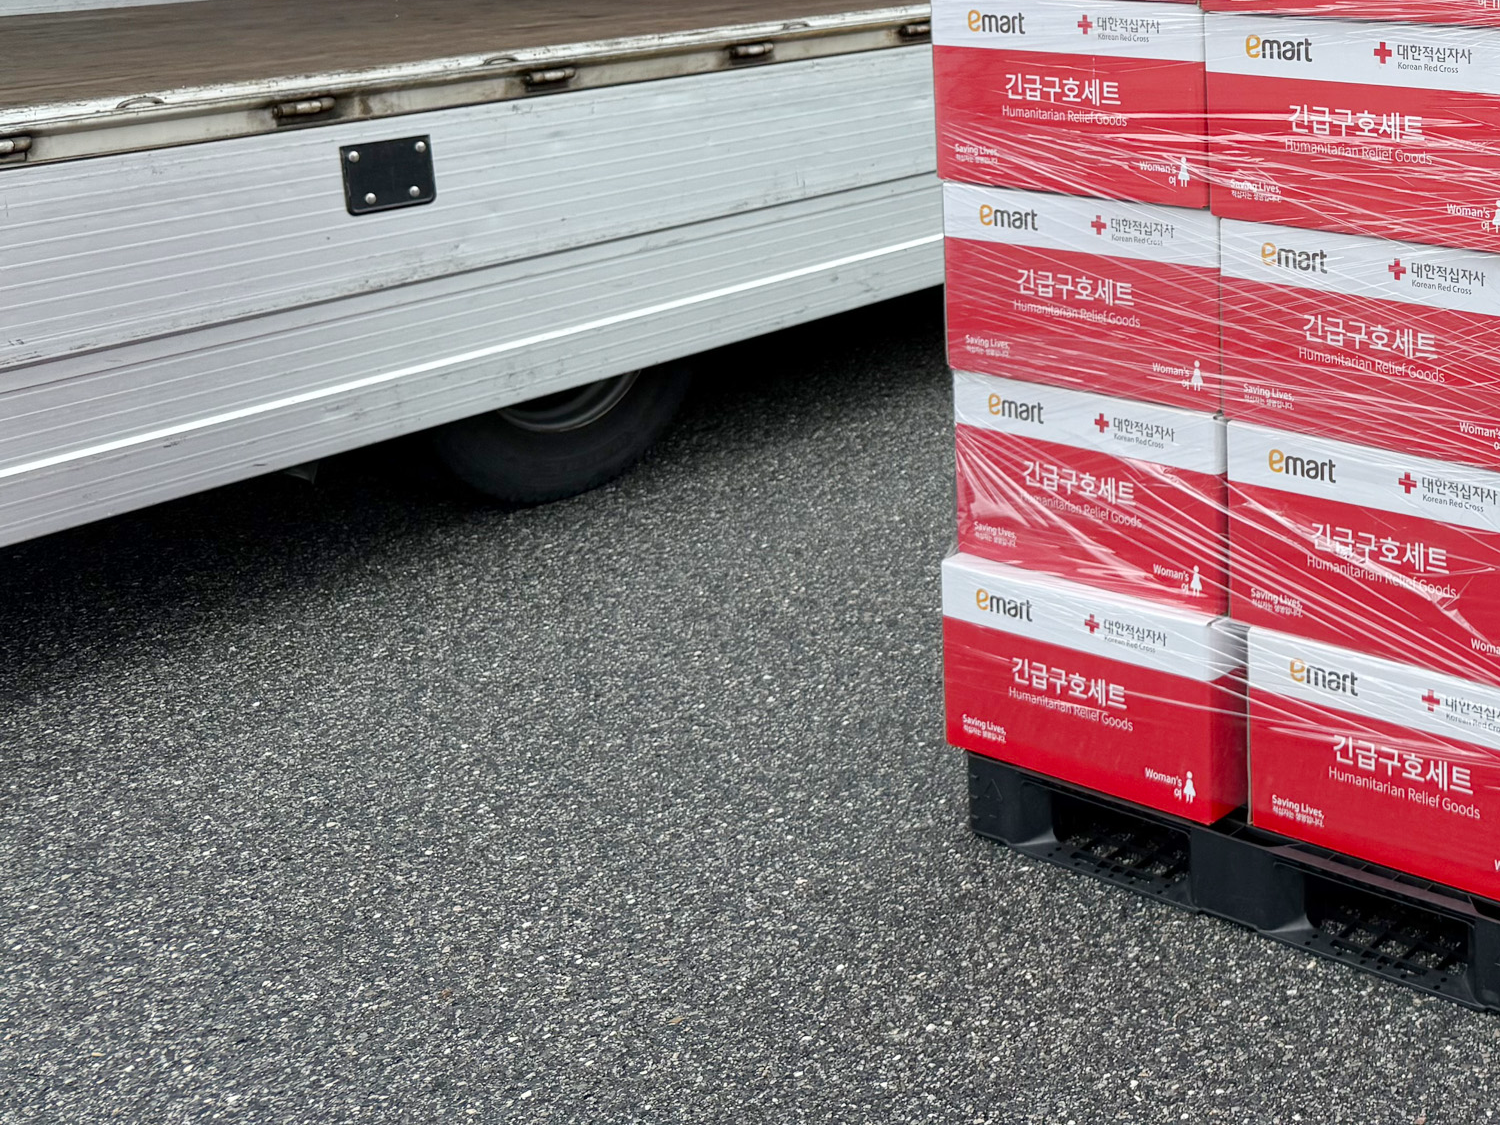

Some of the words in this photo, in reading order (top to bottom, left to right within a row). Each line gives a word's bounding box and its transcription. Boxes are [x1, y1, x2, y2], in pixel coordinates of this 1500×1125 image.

[967, 9, 1026, 35] emart
[1096, 16, 1161, 35] 대한적십자사
[1245, 34, 1313, 63] emart
[1396, 44, 1473, 65] 대한적십자사
[1005, 73, 1121, 107] 긴급구호세트
[1288, 103, 1425, 143] 긴급구호세트
[979, 203, 1038, 232] emart
[1110, 218, 1175, 239] 대한적십자사
[1261, 242, 1328, 275] emart
[1410, 262, 1486, 287] 대한적십자사
[1017, 268, 1135, 306] 긴급구호세트
[1302, 314, 1439, 359] 긴급구호세트
[987, 393, 1044, 425] emart
[1113, 417, 1175, 443] 대한적십자사
[1023, 460, 1136, 506] 긴급구호세트
[1268, 449, 1337, 484] emart
[1421, 477, 1499, 506] 대한적십자사
[1311, 522, 1450, 575] 긴급구호세트
[975, 588, 1033, 623] emart
[1012, 657, 1127, 709] 긴급구호세트
[1289, 658, 1359, 697] emart
[1333, 734, 1474, 795] 긴급구호세트
[1271, 794, 1300, 813] Saving
[1301, 802, 1325, 820] Lives,
[1328, 765, 1405, 798] Humanitarian
[1408, 787, 1441, 808] Relief
[1442, 797, 1481, 820] Goods
